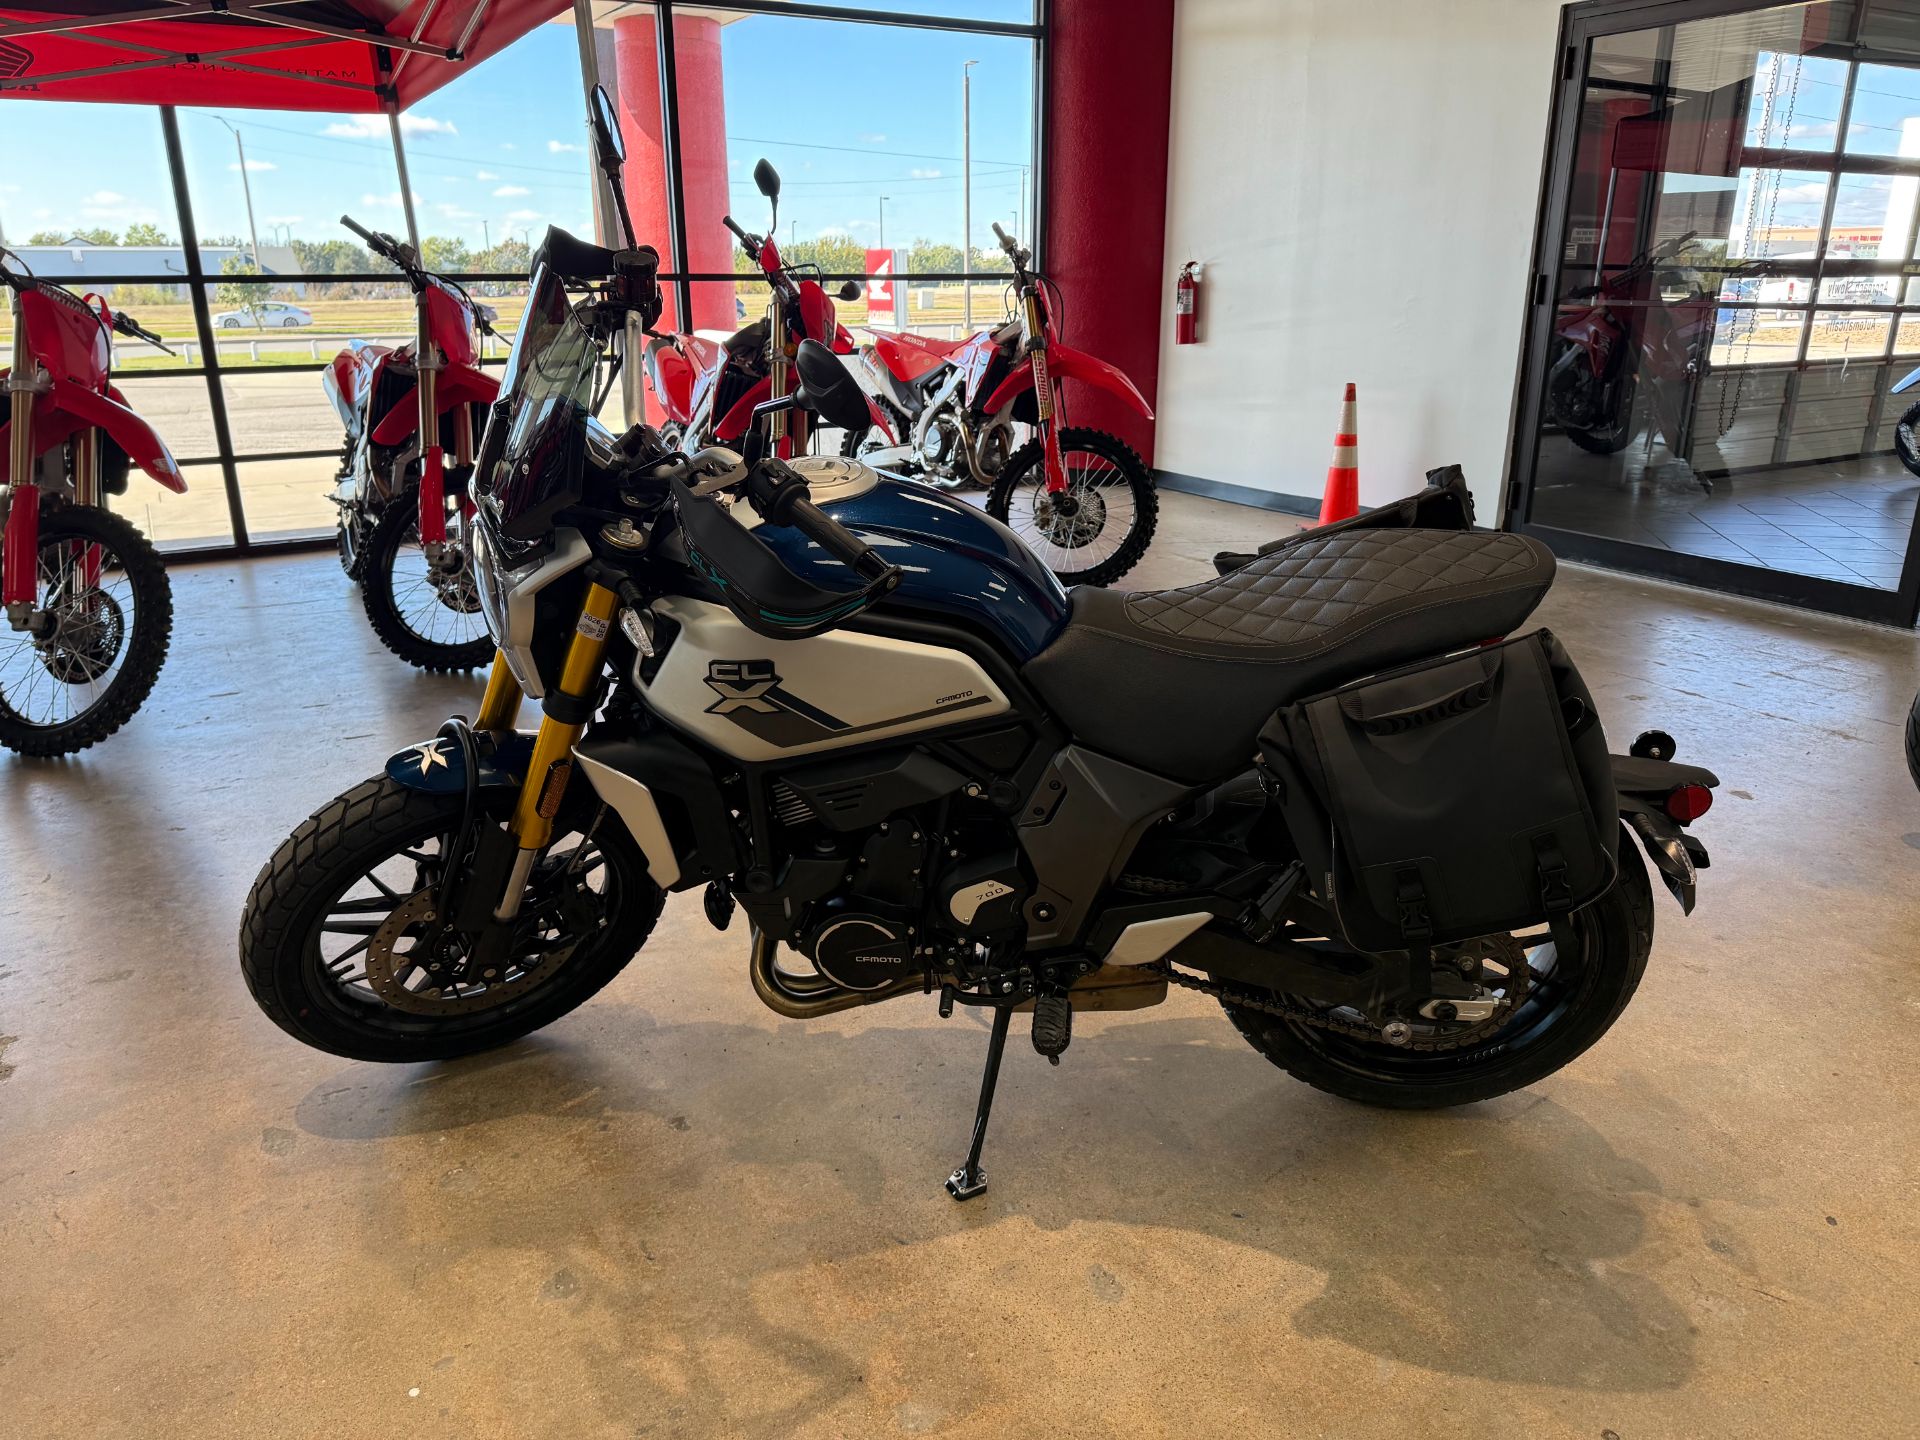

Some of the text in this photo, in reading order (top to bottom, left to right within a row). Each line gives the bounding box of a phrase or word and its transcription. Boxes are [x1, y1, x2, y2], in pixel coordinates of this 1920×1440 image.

[584, 613, 601, 625] 2026
[935, 690, 973, 704] CFMOTO
[975, 887, 1004, 901] 700
[855, 955, 902, 964] CFMOTO
